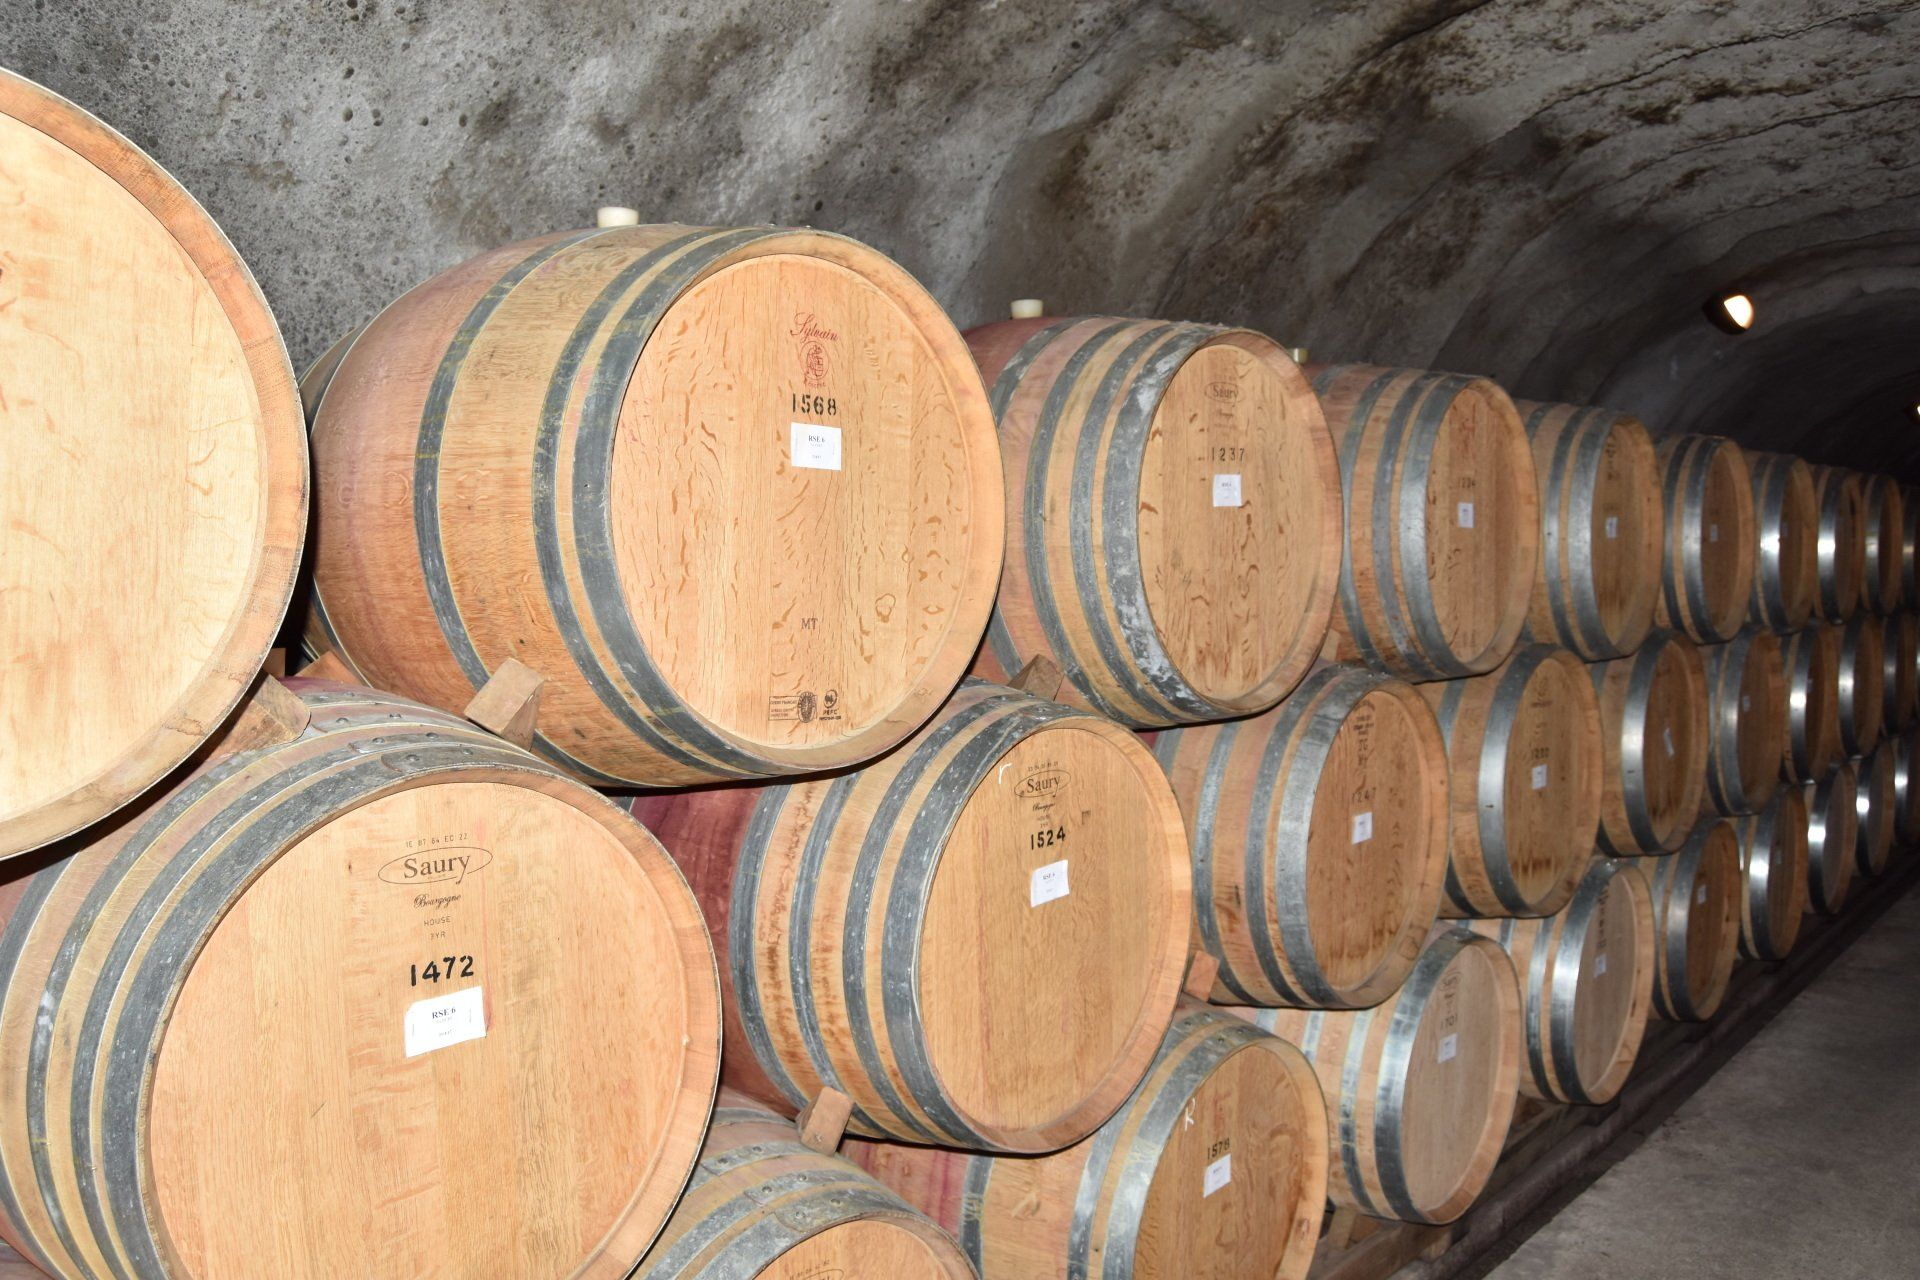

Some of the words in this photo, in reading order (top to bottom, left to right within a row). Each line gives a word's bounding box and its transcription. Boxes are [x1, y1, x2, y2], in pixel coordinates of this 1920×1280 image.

[790, 312, 839, 343] Sylvain
[792, 393, 837, 416] 1568
[1213, 384, 1239, 407] Saury
[1212, 447, 1245, 461] 1237
[800, 617, 819, 630] MT
[1026, 775, 1061, 798] Saury
[1030, 826, 1066, 850] 1524
[403, 855, 471, 885] Saury
[413, 893, 462, 910] Bourgogne
[423, 915, 451, 926] HOUSE
[410, 955, 475, 986] 1472
[432, 1008, 450, 1019] RSE
[1207, 1137, 1230, 1160] 1578
